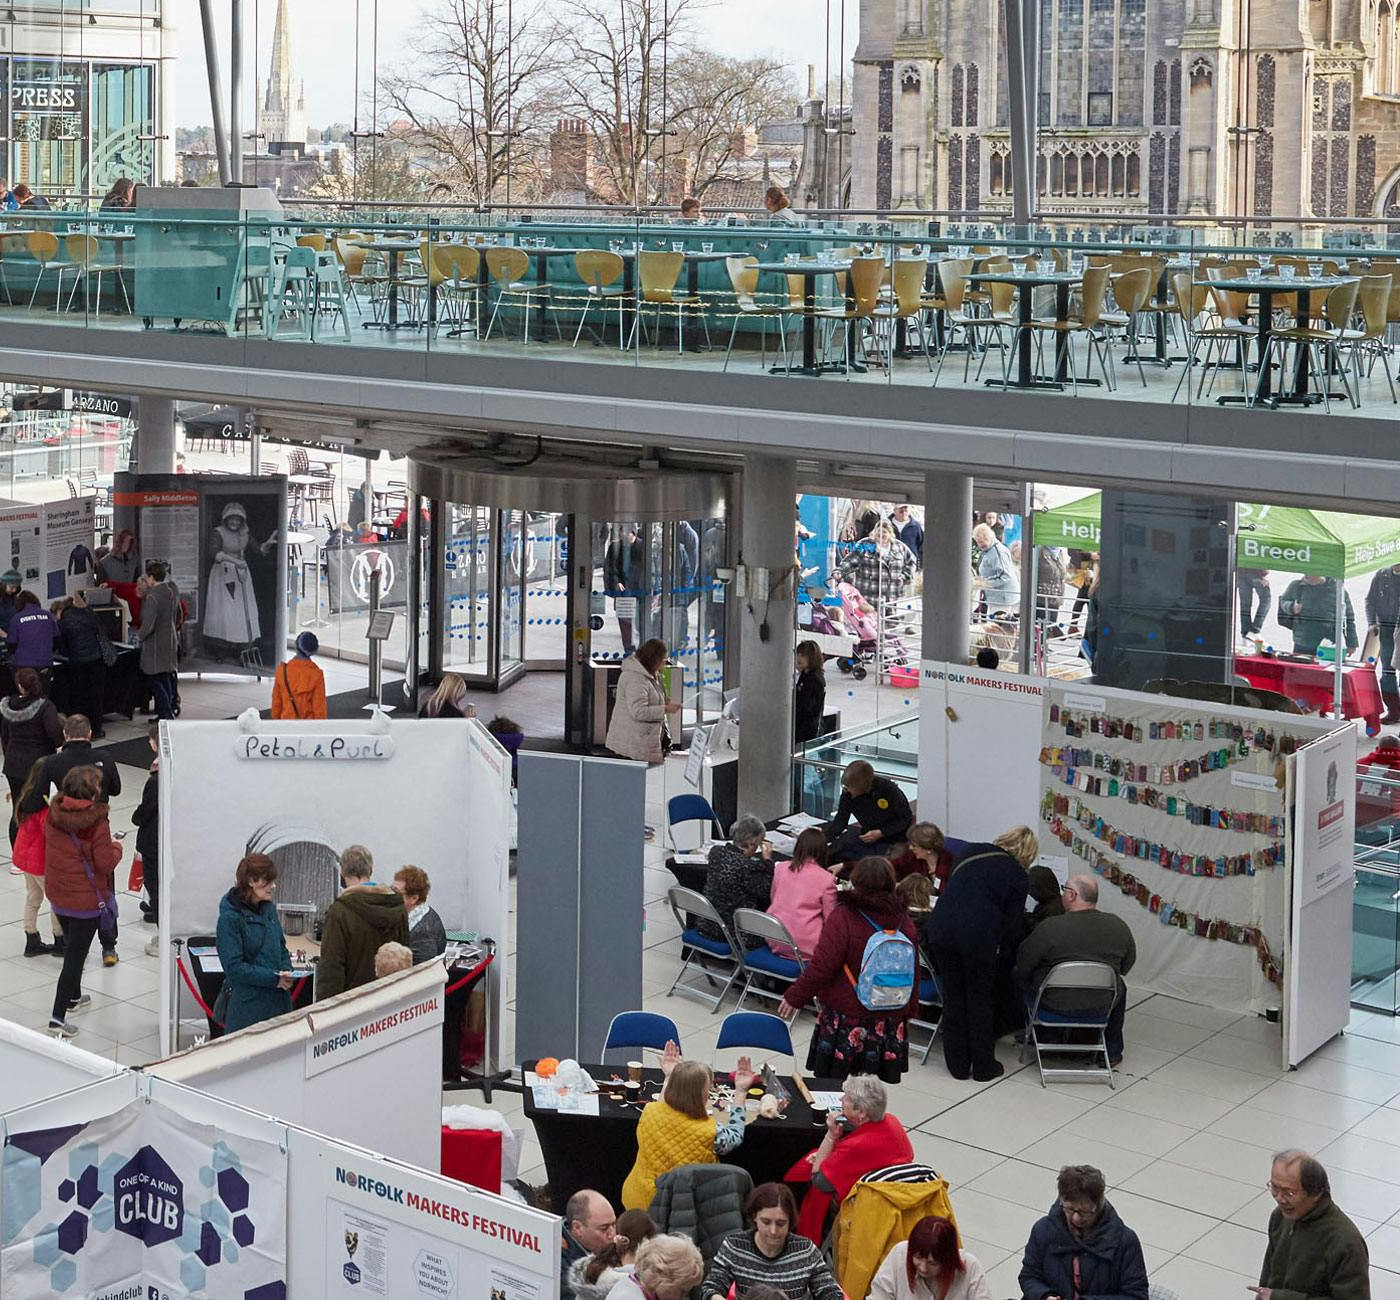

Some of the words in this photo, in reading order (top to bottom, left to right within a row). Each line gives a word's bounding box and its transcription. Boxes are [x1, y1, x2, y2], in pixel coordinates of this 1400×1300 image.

[72, 396, 119, 413] ARZANO
[1243, 539, 1311, 563] Breed
[966, 676, 1002, 690] MAKERS
[1003, 682, 1043, 696] FESTIVAL
[246, 736, 308, 759] Petal
[313, 744, 325, 757] &
[330, 737, 383, 758] Purl
[313, 1030, 359, 1059] NORFOLK
[360, 1013, 398, 1040] MAKERS
[399, 998, 438, 1024] FESTIVAL
[120, 1176, 138, 1188] ONE
[138, 1173, 150, 1183] OF
[150, 1178, 157, 1188] A
[158, 1180, 178, 1195] KIND
[120, 1190, 178, 1231] CLUB
[336, 1167, 403, 1204] NORFOLK
[407, 1191, 469, 1228] MAKERS
[472, 1215, 542, 1254] FESTIVAL
[420, 1262, 447, 1277] INSPIRES
[426, 1254, 442, 1265] WHAT
[418, 1270, 430, 1280] YOU
[430, 1273, 448, 1287] ABOUT
